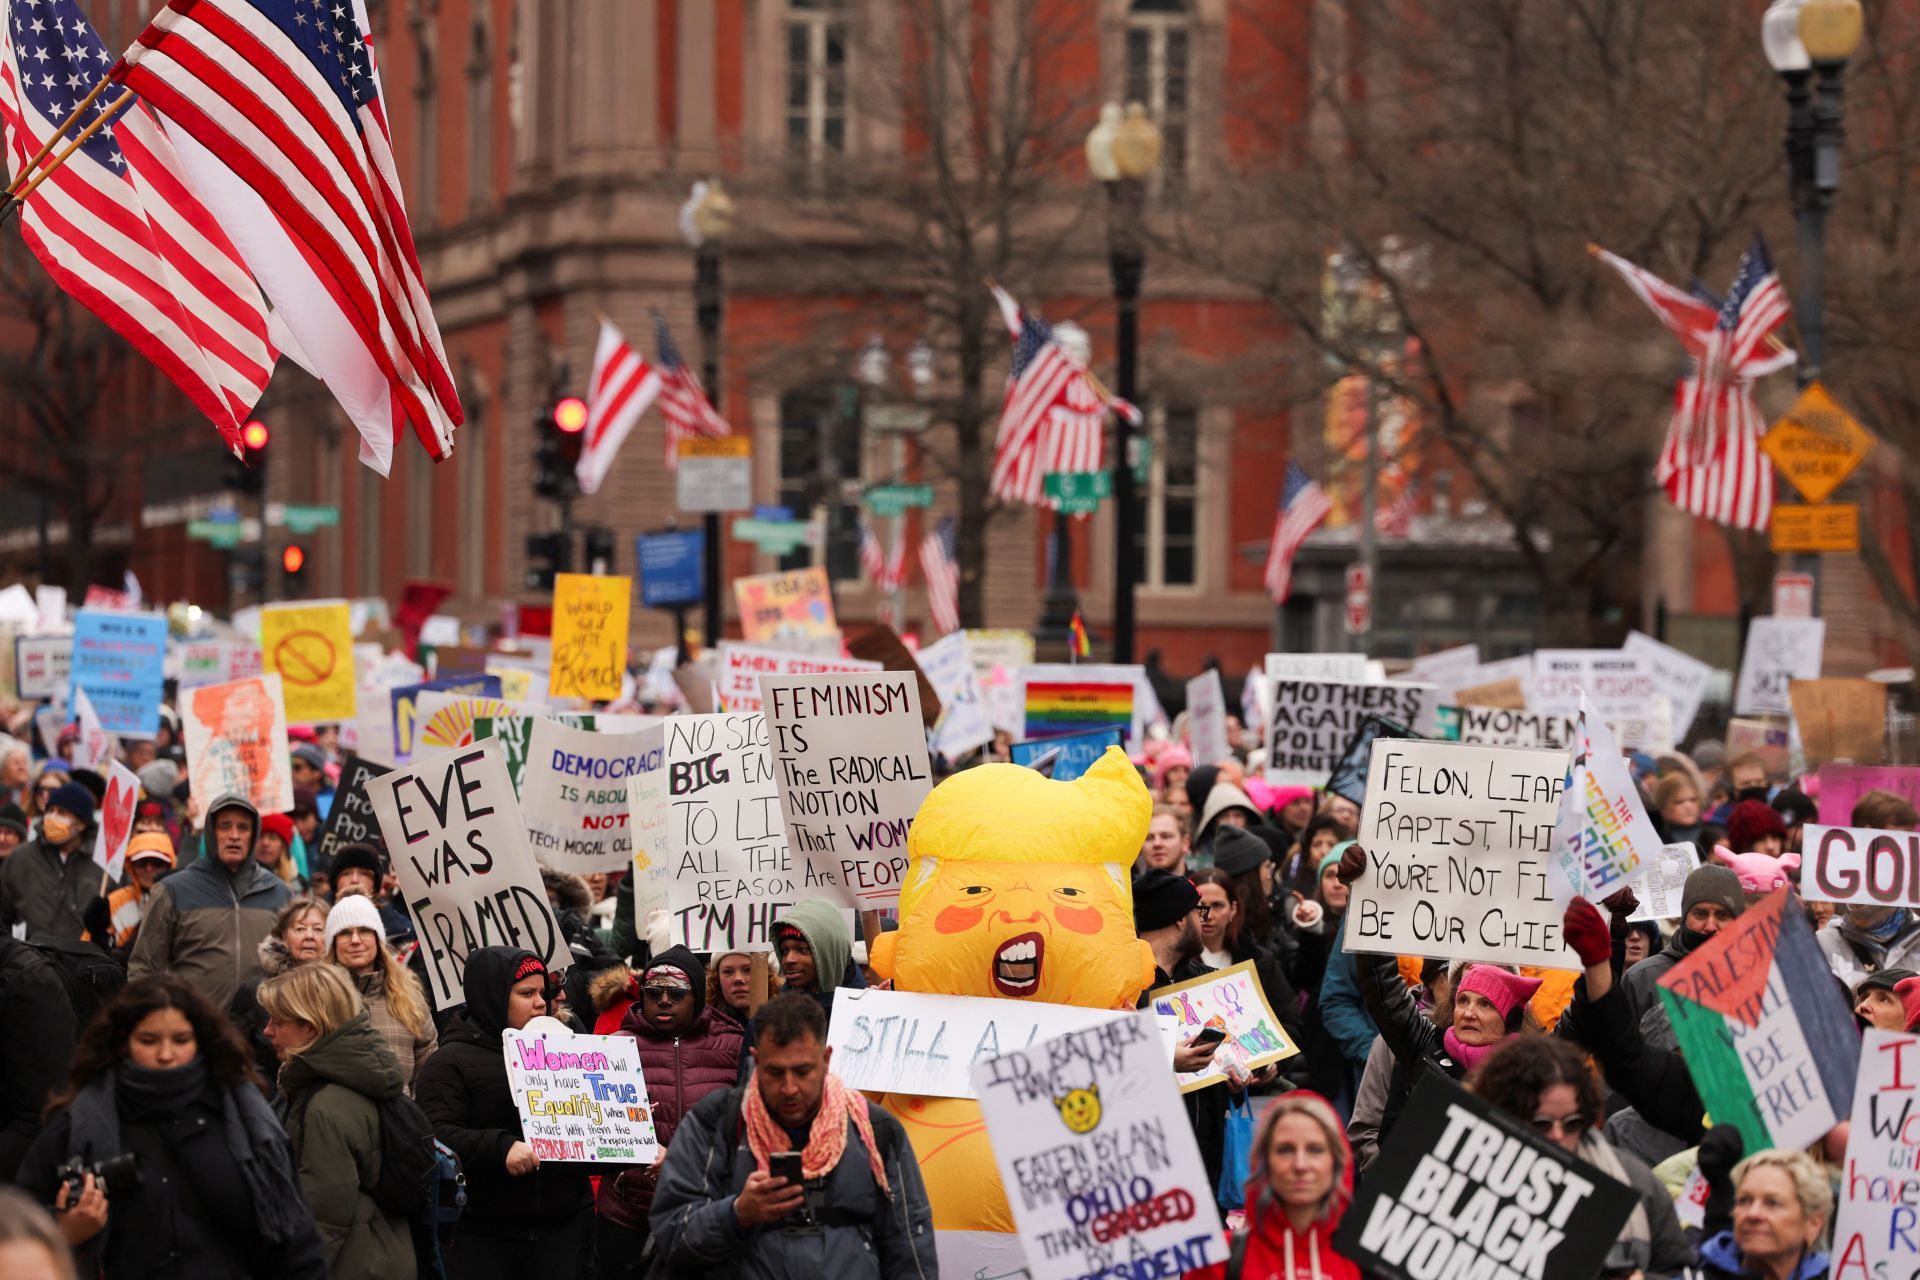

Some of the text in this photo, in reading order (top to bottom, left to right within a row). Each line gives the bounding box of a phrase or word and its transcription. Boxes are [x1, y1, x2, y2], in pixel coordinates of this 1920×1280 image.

[772, 683, 910, 719] FEMINISM
[1277, 681, 1423, 712] MOTHERS
[668, 714, 770, 757] NO SIG
[775, 724, 809, 753] IS
[1272, 729, 1354, 751] POLIC
[669, 752, 774, 795] BIG EN
[779, 754, 926, 786] The RADICAL
[1270, 752, 1341, 774] BRUT
[1383, 753, 1473, 799] FELON,
[392, 750, 494, 844] EVE
[560, 784, 627, 804] IS ABOU
[788, 789, 879, 816] NOTION
[1614, 795, 1634, 828] THE
[529, 829, 560, 850] TECH
[582, 813, 630, 830] NOT
[672, 797, 781, 845] TO LI
[790, 817, 914, 852] That WOM
[1499, 809, 1556, 852] THI
[411, 830, 493, 888] WAS
[676, 844, 792, 879] ALL THE
[805, 856, 910, 888] Are PEOP
[1449, 855, 1502, 897] NOT
[1517, 860, 1555, 901] FI
[1567, 826, 1621, 890] RCH
[1815, 828, 1920, 903] GO
[698, 879, 795, 901] REASO
[412, 886, 555, 1000] FRAMED
[673, 903, 736, 951] I'M
[1358, 899, 1567, 953] BE OUR CHIE
[1669, 908, 1789, 1020] PALESTIN
[1717, 979, 1789, 1048] WILL
[516, 1039, 609, 1072] Women
[843, 1015, 948, 1061] STILL
[971, 1019, 1001, 1064] A
[1046, 1014, 1148, 1066] RATHER
[1749, 1027, 1792, 1081] BE
[554, 1073, 580, 1088] have
[583, 1073, 637, 1104] True
[1878, 1040, 1917, 1092] I
[526, 1089, 603, 1126] Equality
[1751, 1060, 1821, 1140] FREE
[588, 1123, 612, 1135] them
[614, 1123, 631, 1135] the
[1012, 1116, 1168, 1184] EATEN BY AN
[1432, 1103, 1595, 1230] TRUST
[1066, 1176, 1154, 1227] OHIO
[1091, 1187, 1196, 1245] GRABBED
[1399, 1153, 1566, 1280] BLACK
[1130, 1236, 1151, 1259] A
[1359, 1193, 1528, 1280] WOM
[1888, 1207, 1920, 1254] R
[1069, 1234, 1213, 1280] SIDENT
